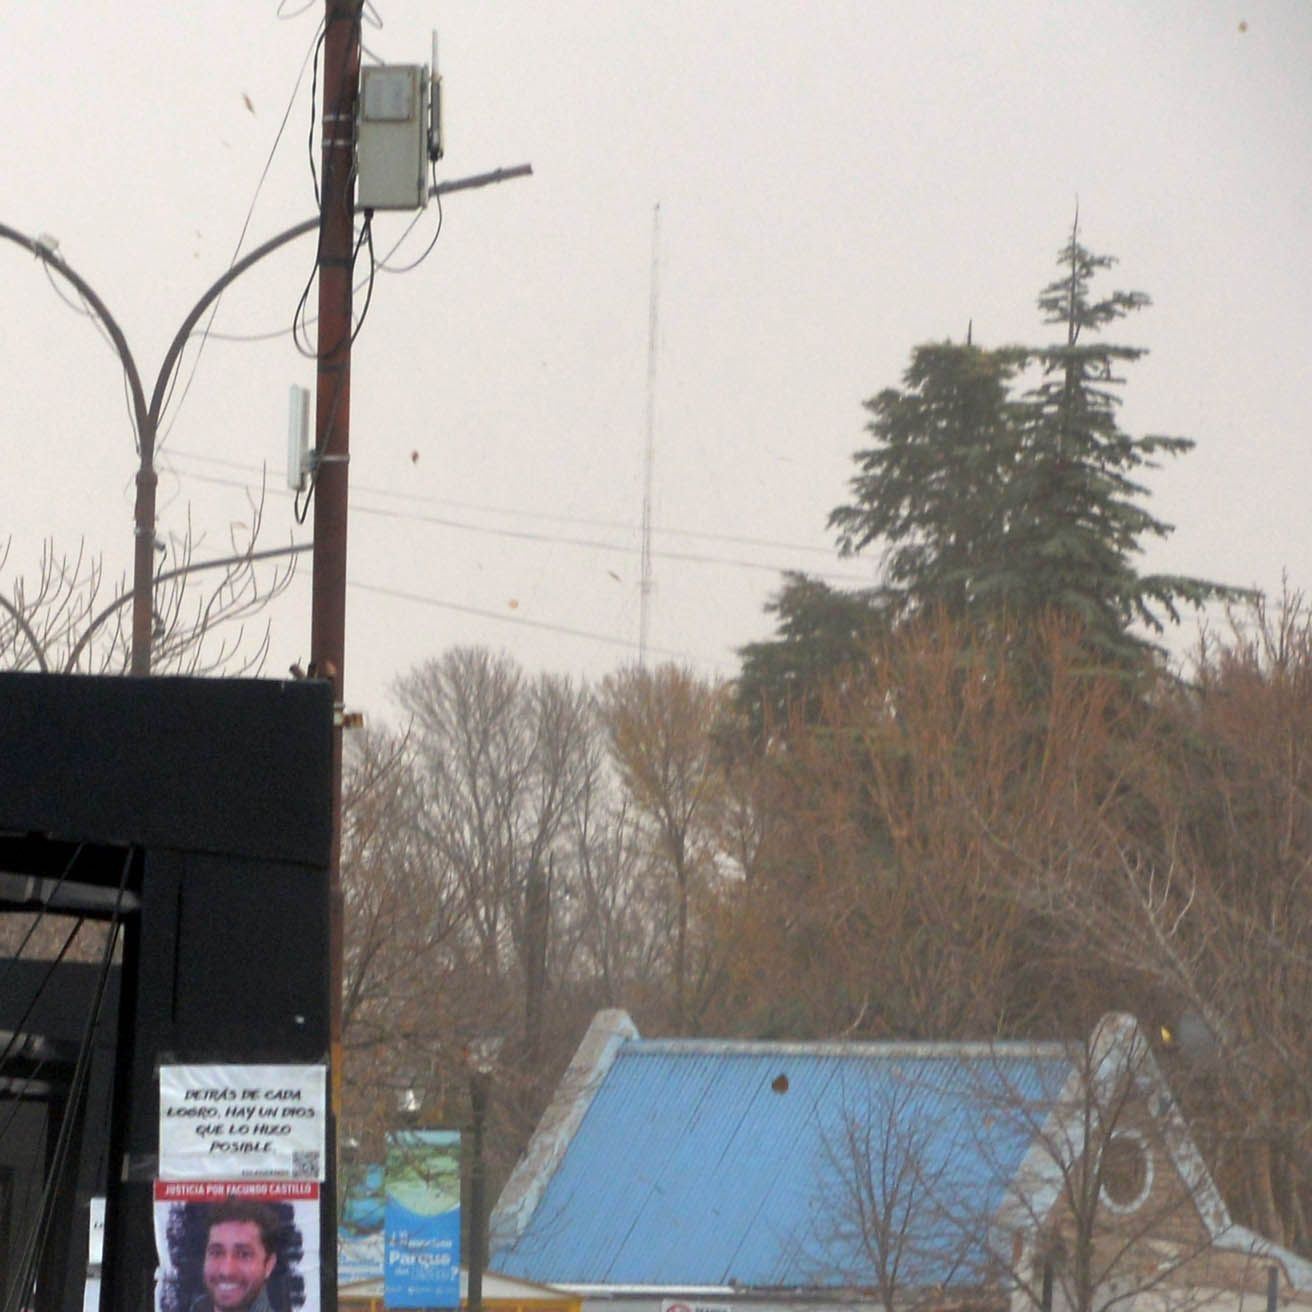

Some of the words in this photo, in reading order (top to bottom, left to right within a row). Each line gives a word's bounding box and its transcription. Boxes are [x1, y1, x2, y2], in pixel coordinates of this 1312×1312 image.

[184, 1087, 236, 1101] DETRÁS
[241, 1089, 259, 1101] DE
[264, 1089, 301, 1101] CADA
[225, 1106, 256, 1121] HAY
[258, 1106, 278, 1118] UN
[281, 1106, 315, 1118] DIOS
[195, 1124, 224, 1137] QUE
[228, 1124, 249, 1136] LO
[253, 1123, 292, 1136] HIZO
[209, 1140, 272, 1154] POSIBLE
[165, 1183, 204, 1195] JUSTICIA
[206, 1183, 224, 1195] POR
[226, 1183, 267, 1195] FACUNDO
[269, 1183, 312, 1195] CASTILLO
[389, 1250, 451, 1269] Parque
